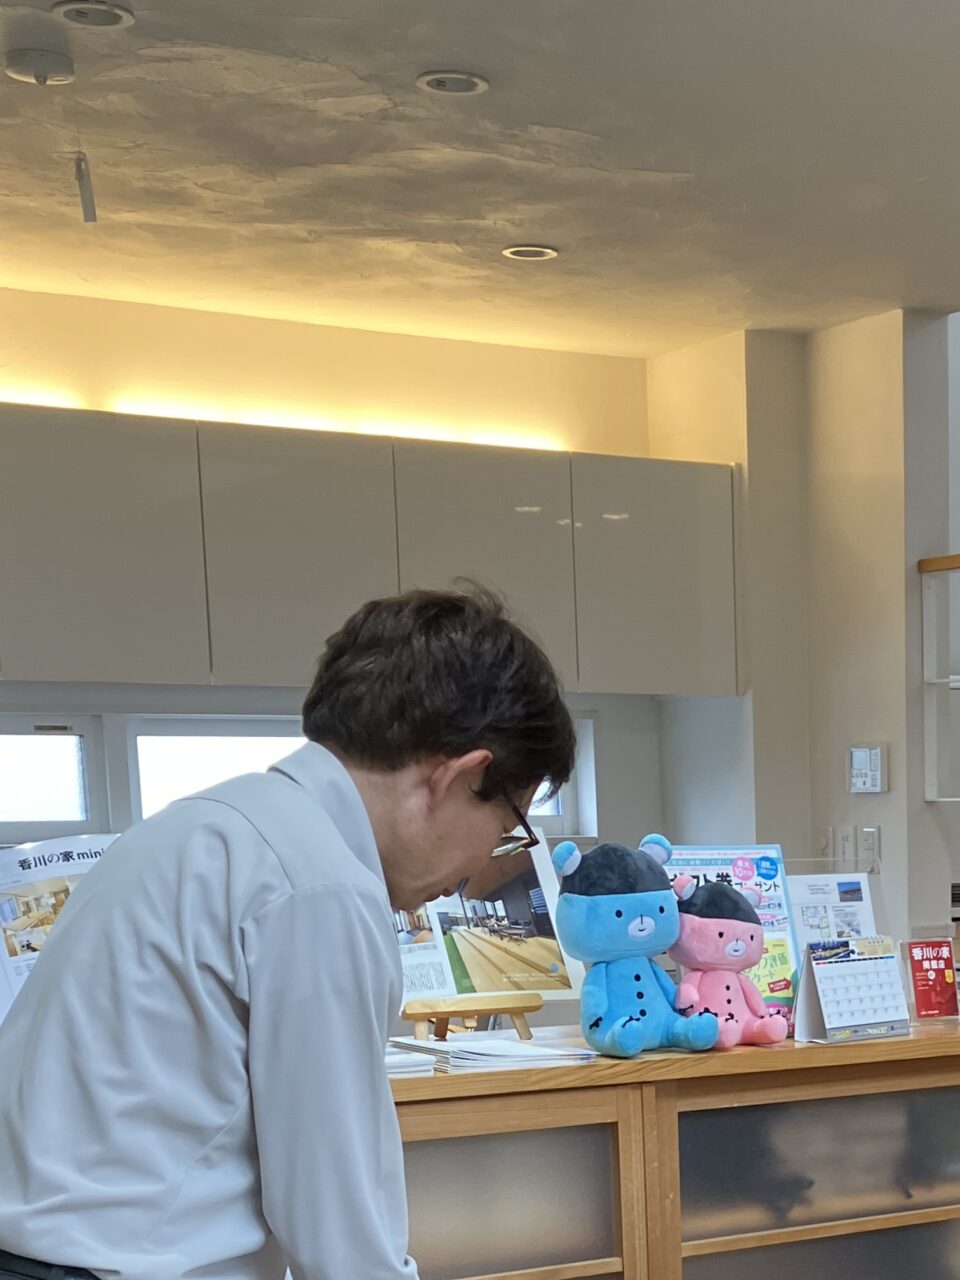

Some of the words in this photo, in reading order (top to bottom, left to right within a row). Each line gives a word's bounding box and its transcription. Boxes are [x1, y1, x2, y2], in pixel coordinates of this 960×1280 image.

[912, 947, 950, 960] 香川の家
[922, 960, 946, 969] 掲載店
